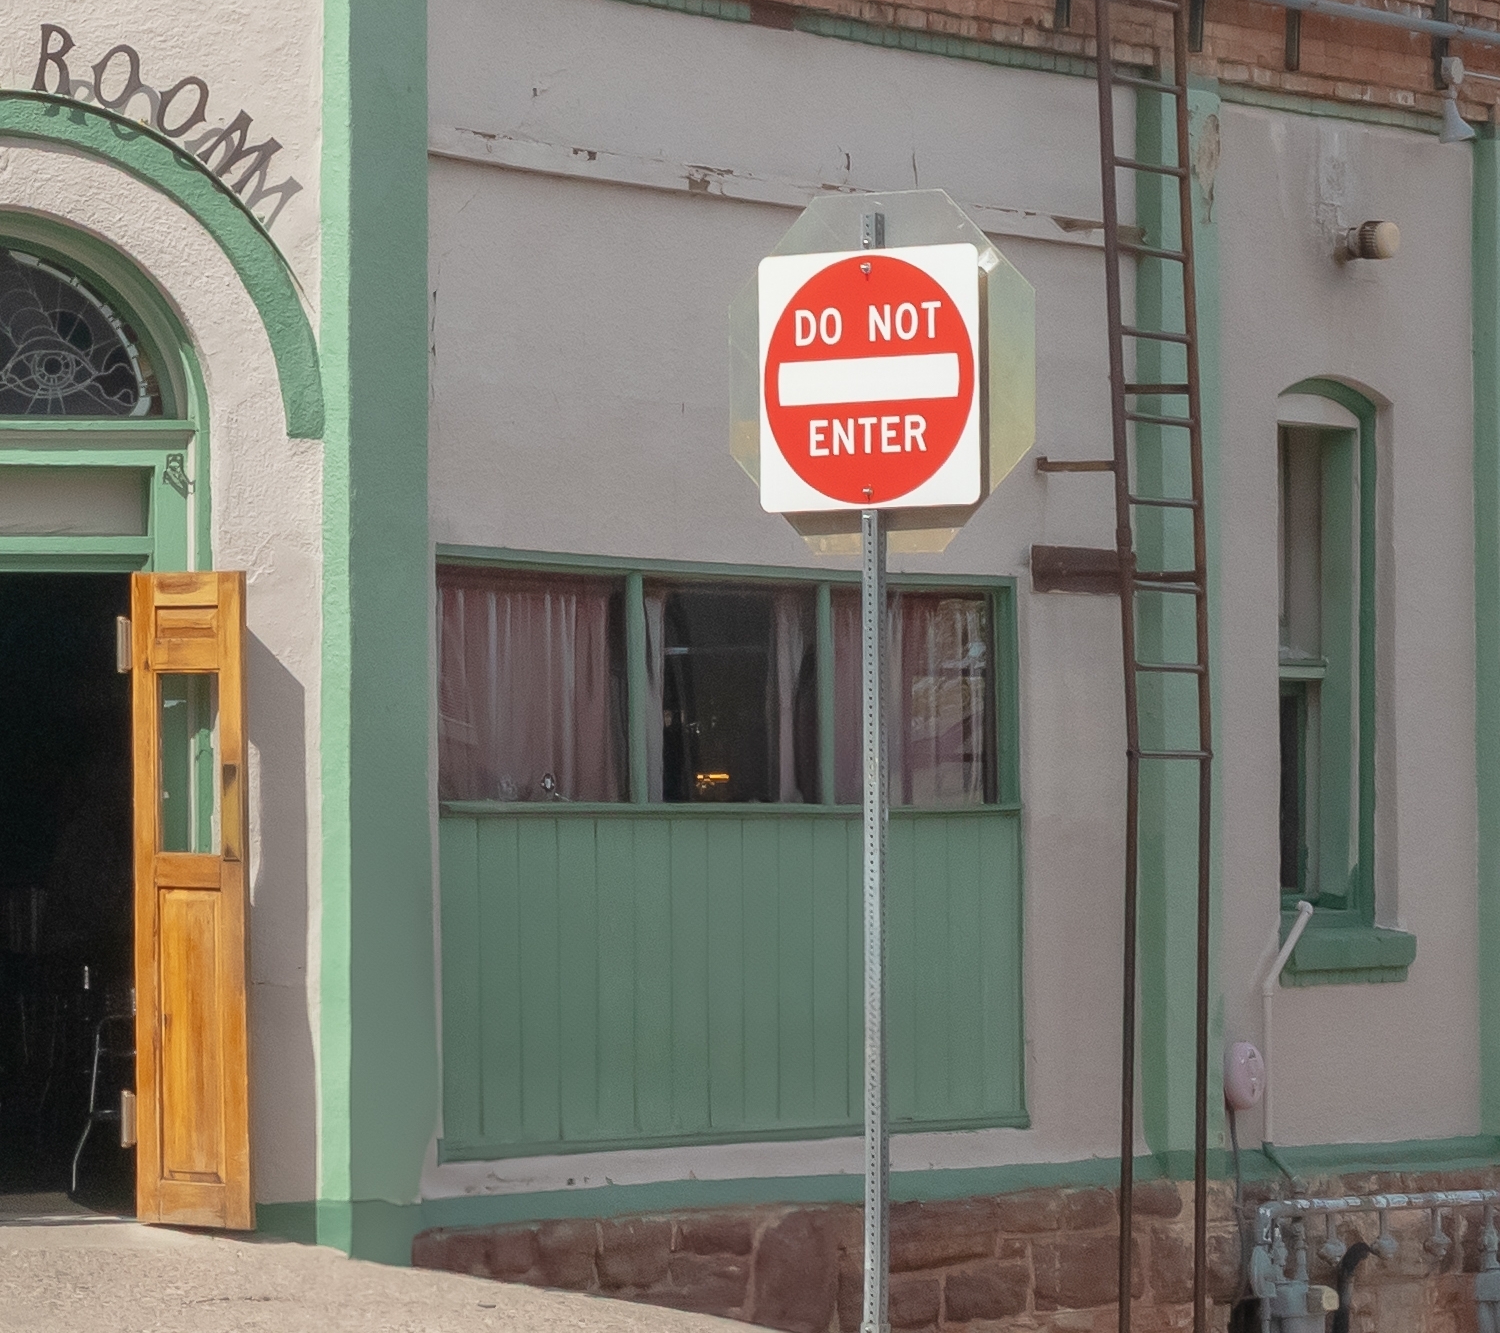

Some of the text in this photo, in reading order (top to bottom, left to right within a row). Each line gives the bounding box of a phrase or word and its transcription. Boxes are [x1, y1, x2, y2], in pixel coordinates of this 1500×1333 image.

[31, 23, 284, 196] ROOM
[794, 300, 942, 347] DO NOT
[808, 414, 928, 457] ENTER
